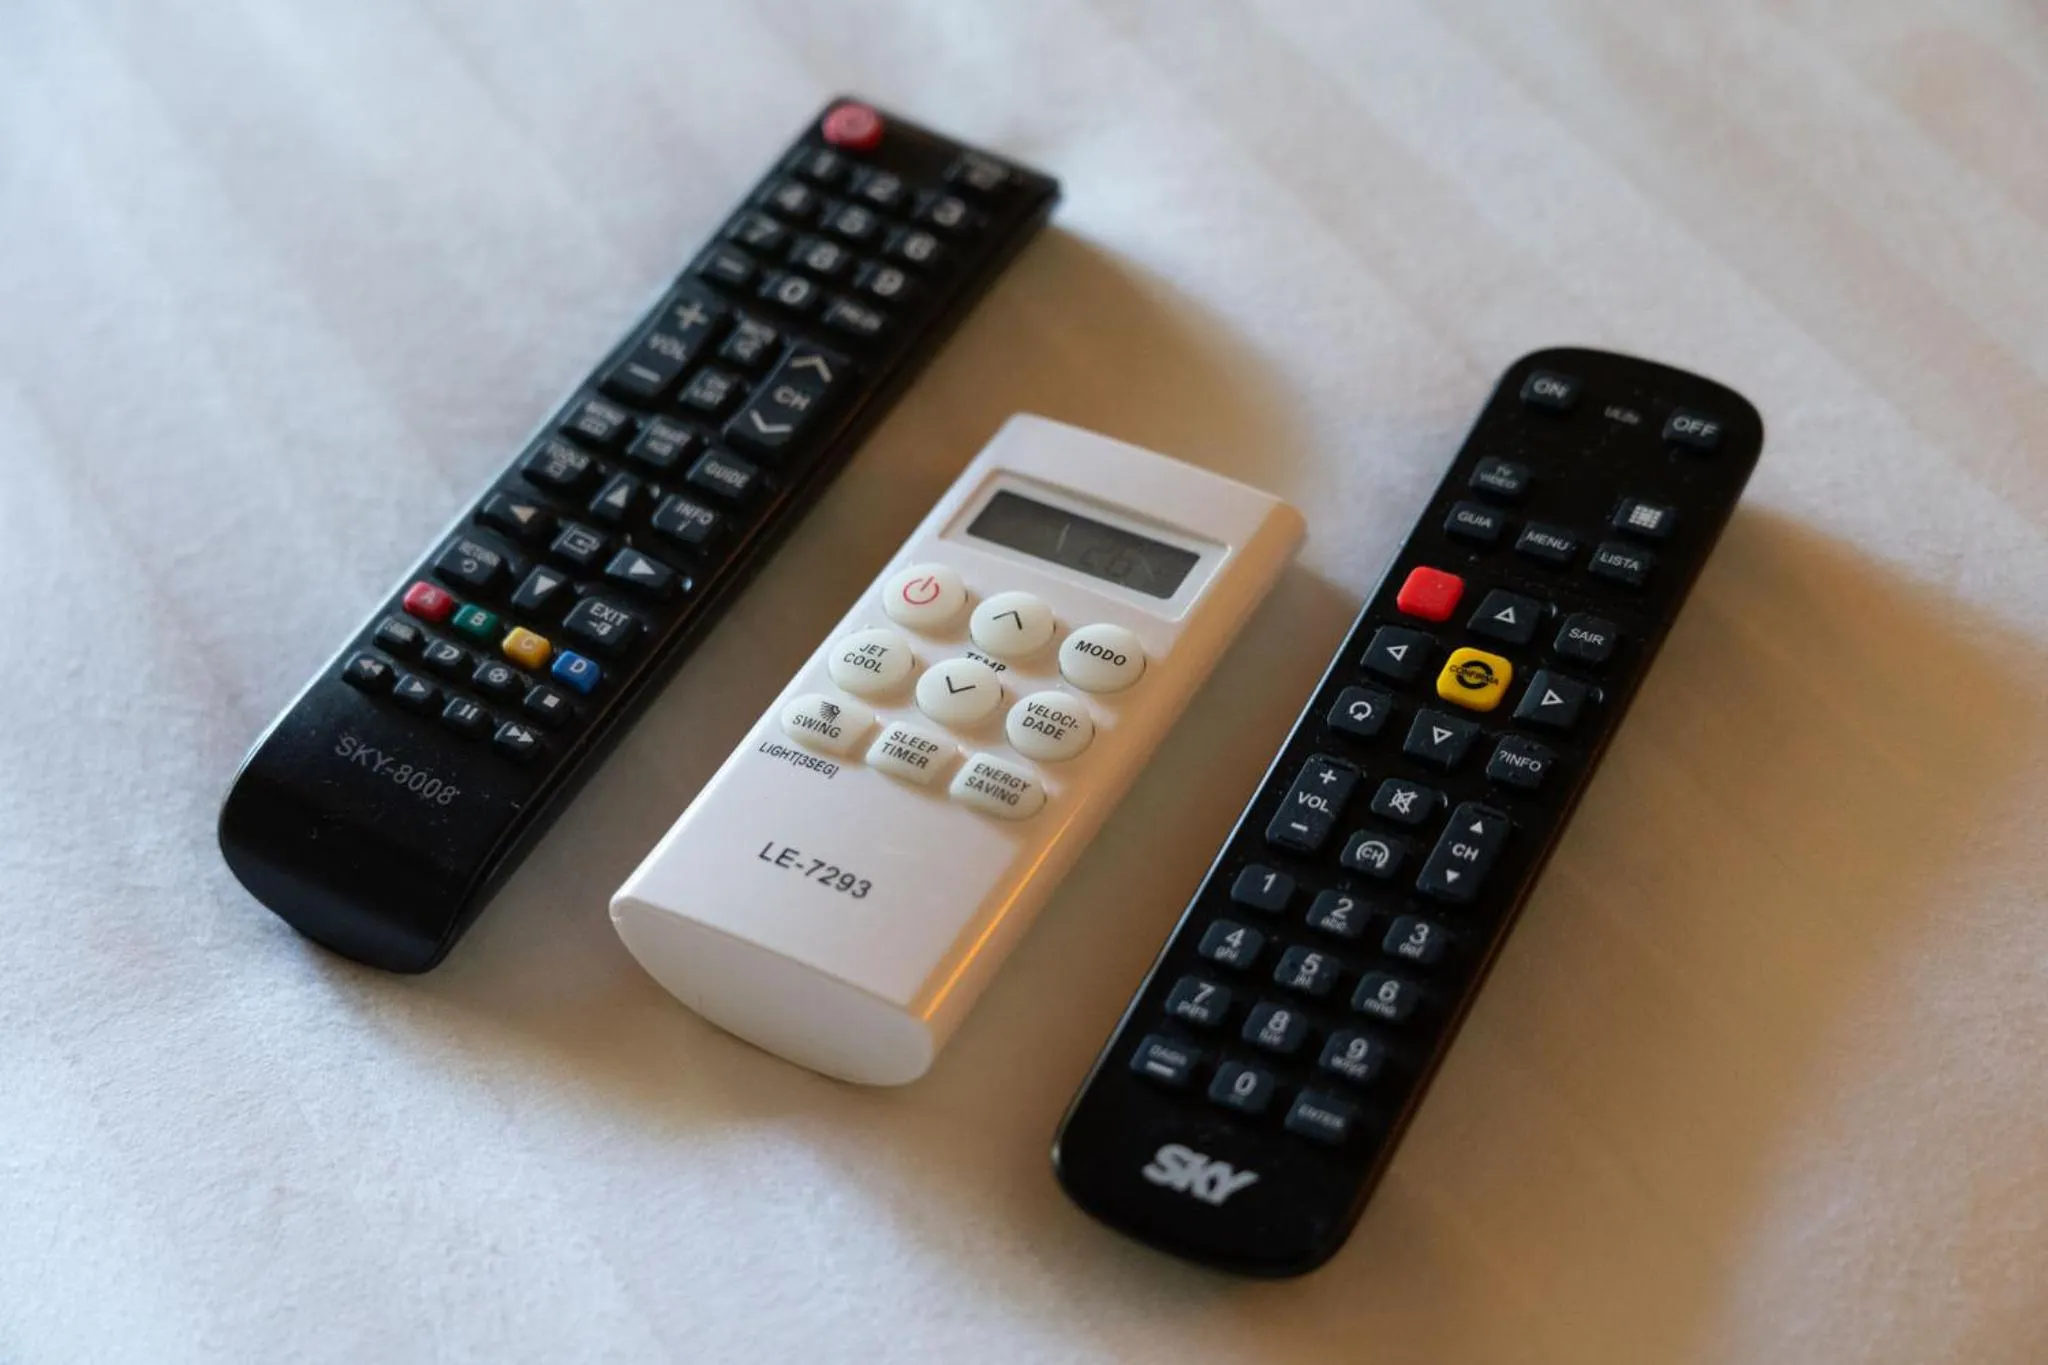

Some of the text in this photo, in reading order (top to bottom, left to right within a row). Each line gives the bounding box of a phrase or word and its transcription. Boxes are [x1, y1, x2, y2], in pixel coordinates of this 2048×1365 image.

[778, 276, 809, 305] 0
[1533, 377, 1571, 400] ON
[1672, 415, 1720, 438] OFF
[704, 462, 749, 488] GUIDE
[676, 502, 714, 525] INFO
[1458, 510, 1494, 530] GUIA
[1526, 530, 1570, 552] MENU
[1600, 551, 1640, 573] LISTA
[469, 611, 486, 625] B
[590, 603, 628, 627] EXIT
[1568, 627, 1605, 647] SAIR
[858, 642, 888, 659] JET
[1075, 639, 1127, 667] MODO
[569, 660, 587, 674] D
[843, 652, 883, 674] COOL
[792, 714, 842, 739] SWING
[1026, 701, 1080, 731] VELOCI-
[1021, 716, 1066, 741] DADE
[890, 730, 939, 755] SLEEP
[881, 742, 930, 770] TIMER
[335, 735, 456, 805] SKY-8008
[973, 763, 1032, 794] ENERGY
[964, 775, 1020, 807] SAVING
[1298, 792, 1330, 814] VOL
[1361, 846, 1385, 863] CH
[1452, 843, 1479, 862] CH
[758, 841, 874, 901] LE-7293
[1262, 873, 1277, 894] 1
[1331, 897, 1354, 920] 2
[1225, 927, 1246, 948] 4
[1408, 923, 1430, 944] 3
[1300, 953, 1323, 975] 5
[1193, 982, 1216, 1003] 7
[1378, 980, 1400, 1003] 6
[1267, 1010, 1291, 1033] 8
[1347, 1038, 1369, 1061] 9
[1235, 1071, 1257, 1096] 0
[1142, 1143, 1260, 1205] SKY
